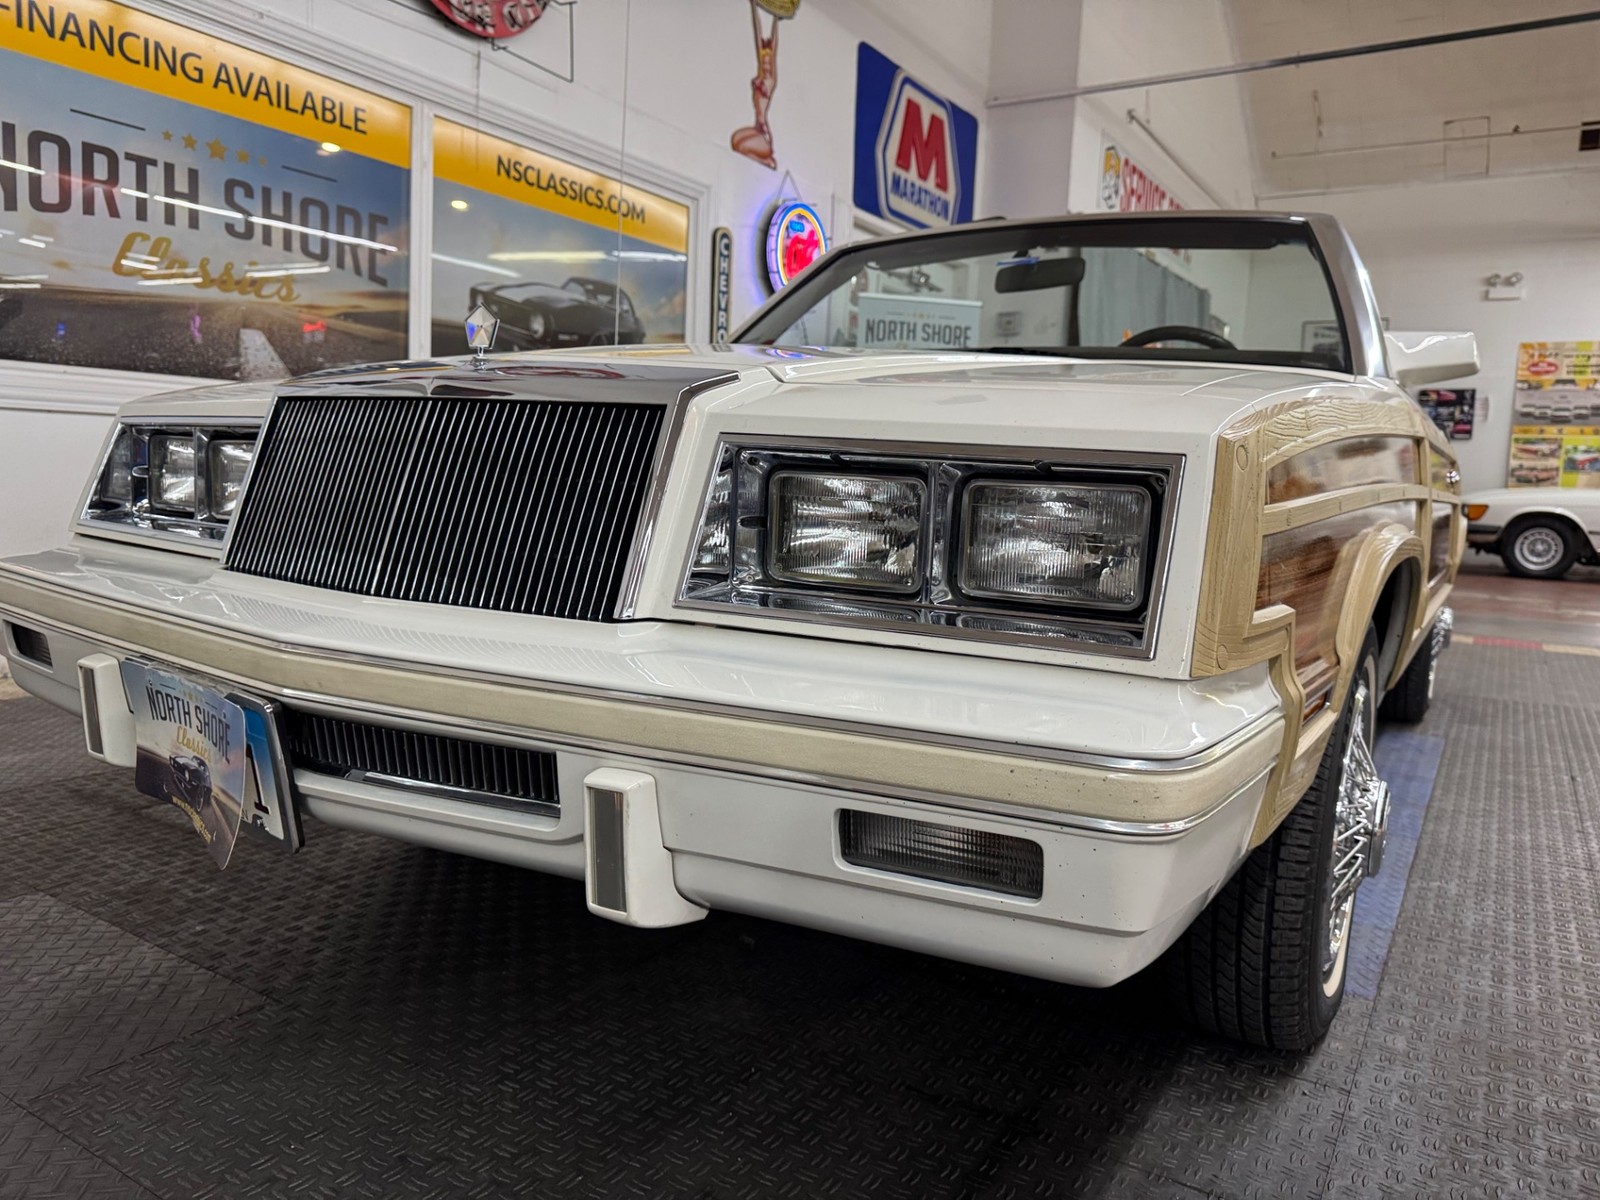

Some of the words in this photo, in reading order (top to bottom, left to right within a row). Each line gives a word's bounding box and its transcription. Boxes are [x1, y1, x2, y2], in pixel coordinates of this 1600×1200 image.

[212, 62, 368, 136] AVAILABLE
[895, 97, 949, 193] M
[496, 155, 646, 223] NSCLASSICS.COM
[890, 171, 950, 222] MARATHON
[111, 231, 301, 302] Classics
[223, 178, 390, 288] SHORE
[864, 317, 918, 345] NORTH
[920, 322, 972, 349] SHORE
[145, 684, 193, 728] NORTH
[195, 705, 231, 765] SHORE
